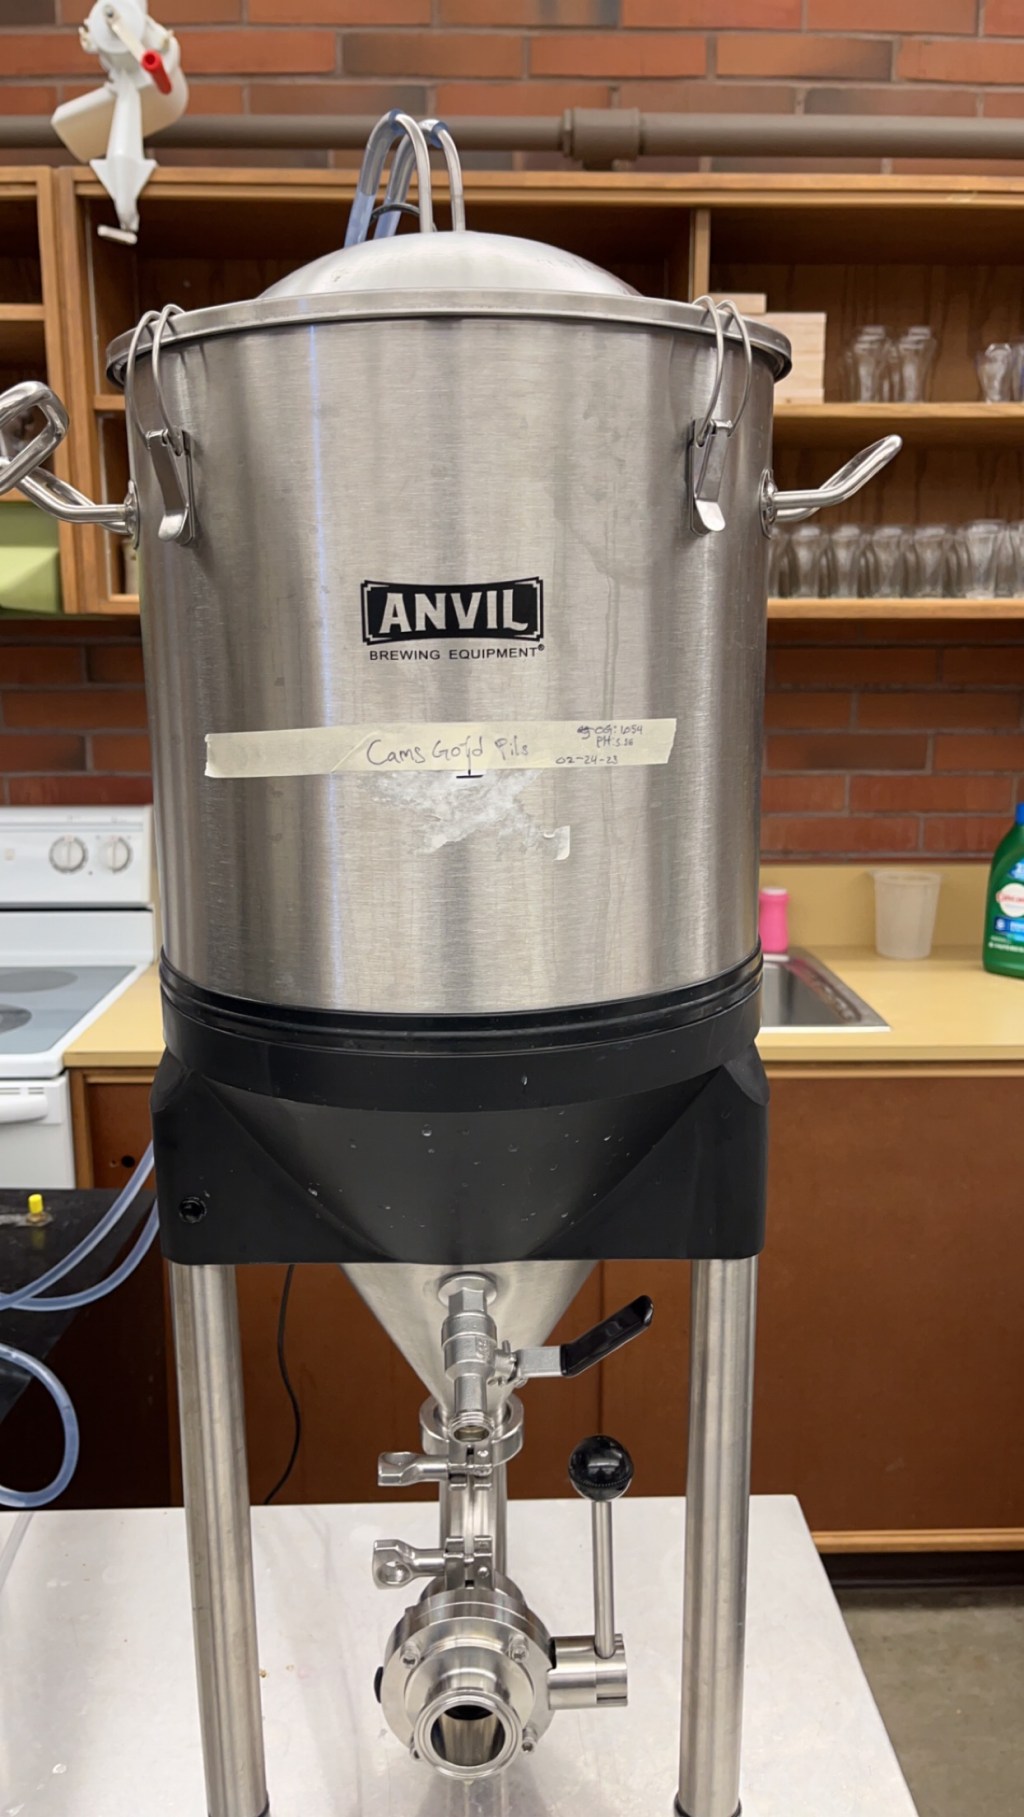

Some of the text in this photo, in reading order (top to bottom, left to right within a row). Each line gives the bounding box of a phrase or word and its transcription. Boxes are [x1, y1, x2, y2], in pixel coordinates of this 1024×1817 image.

[379, 589, 529, 634] ANVIL
[369, 649, 441, 661] BREWING
[366, 735, 530, 766] Cams Gold Pils
